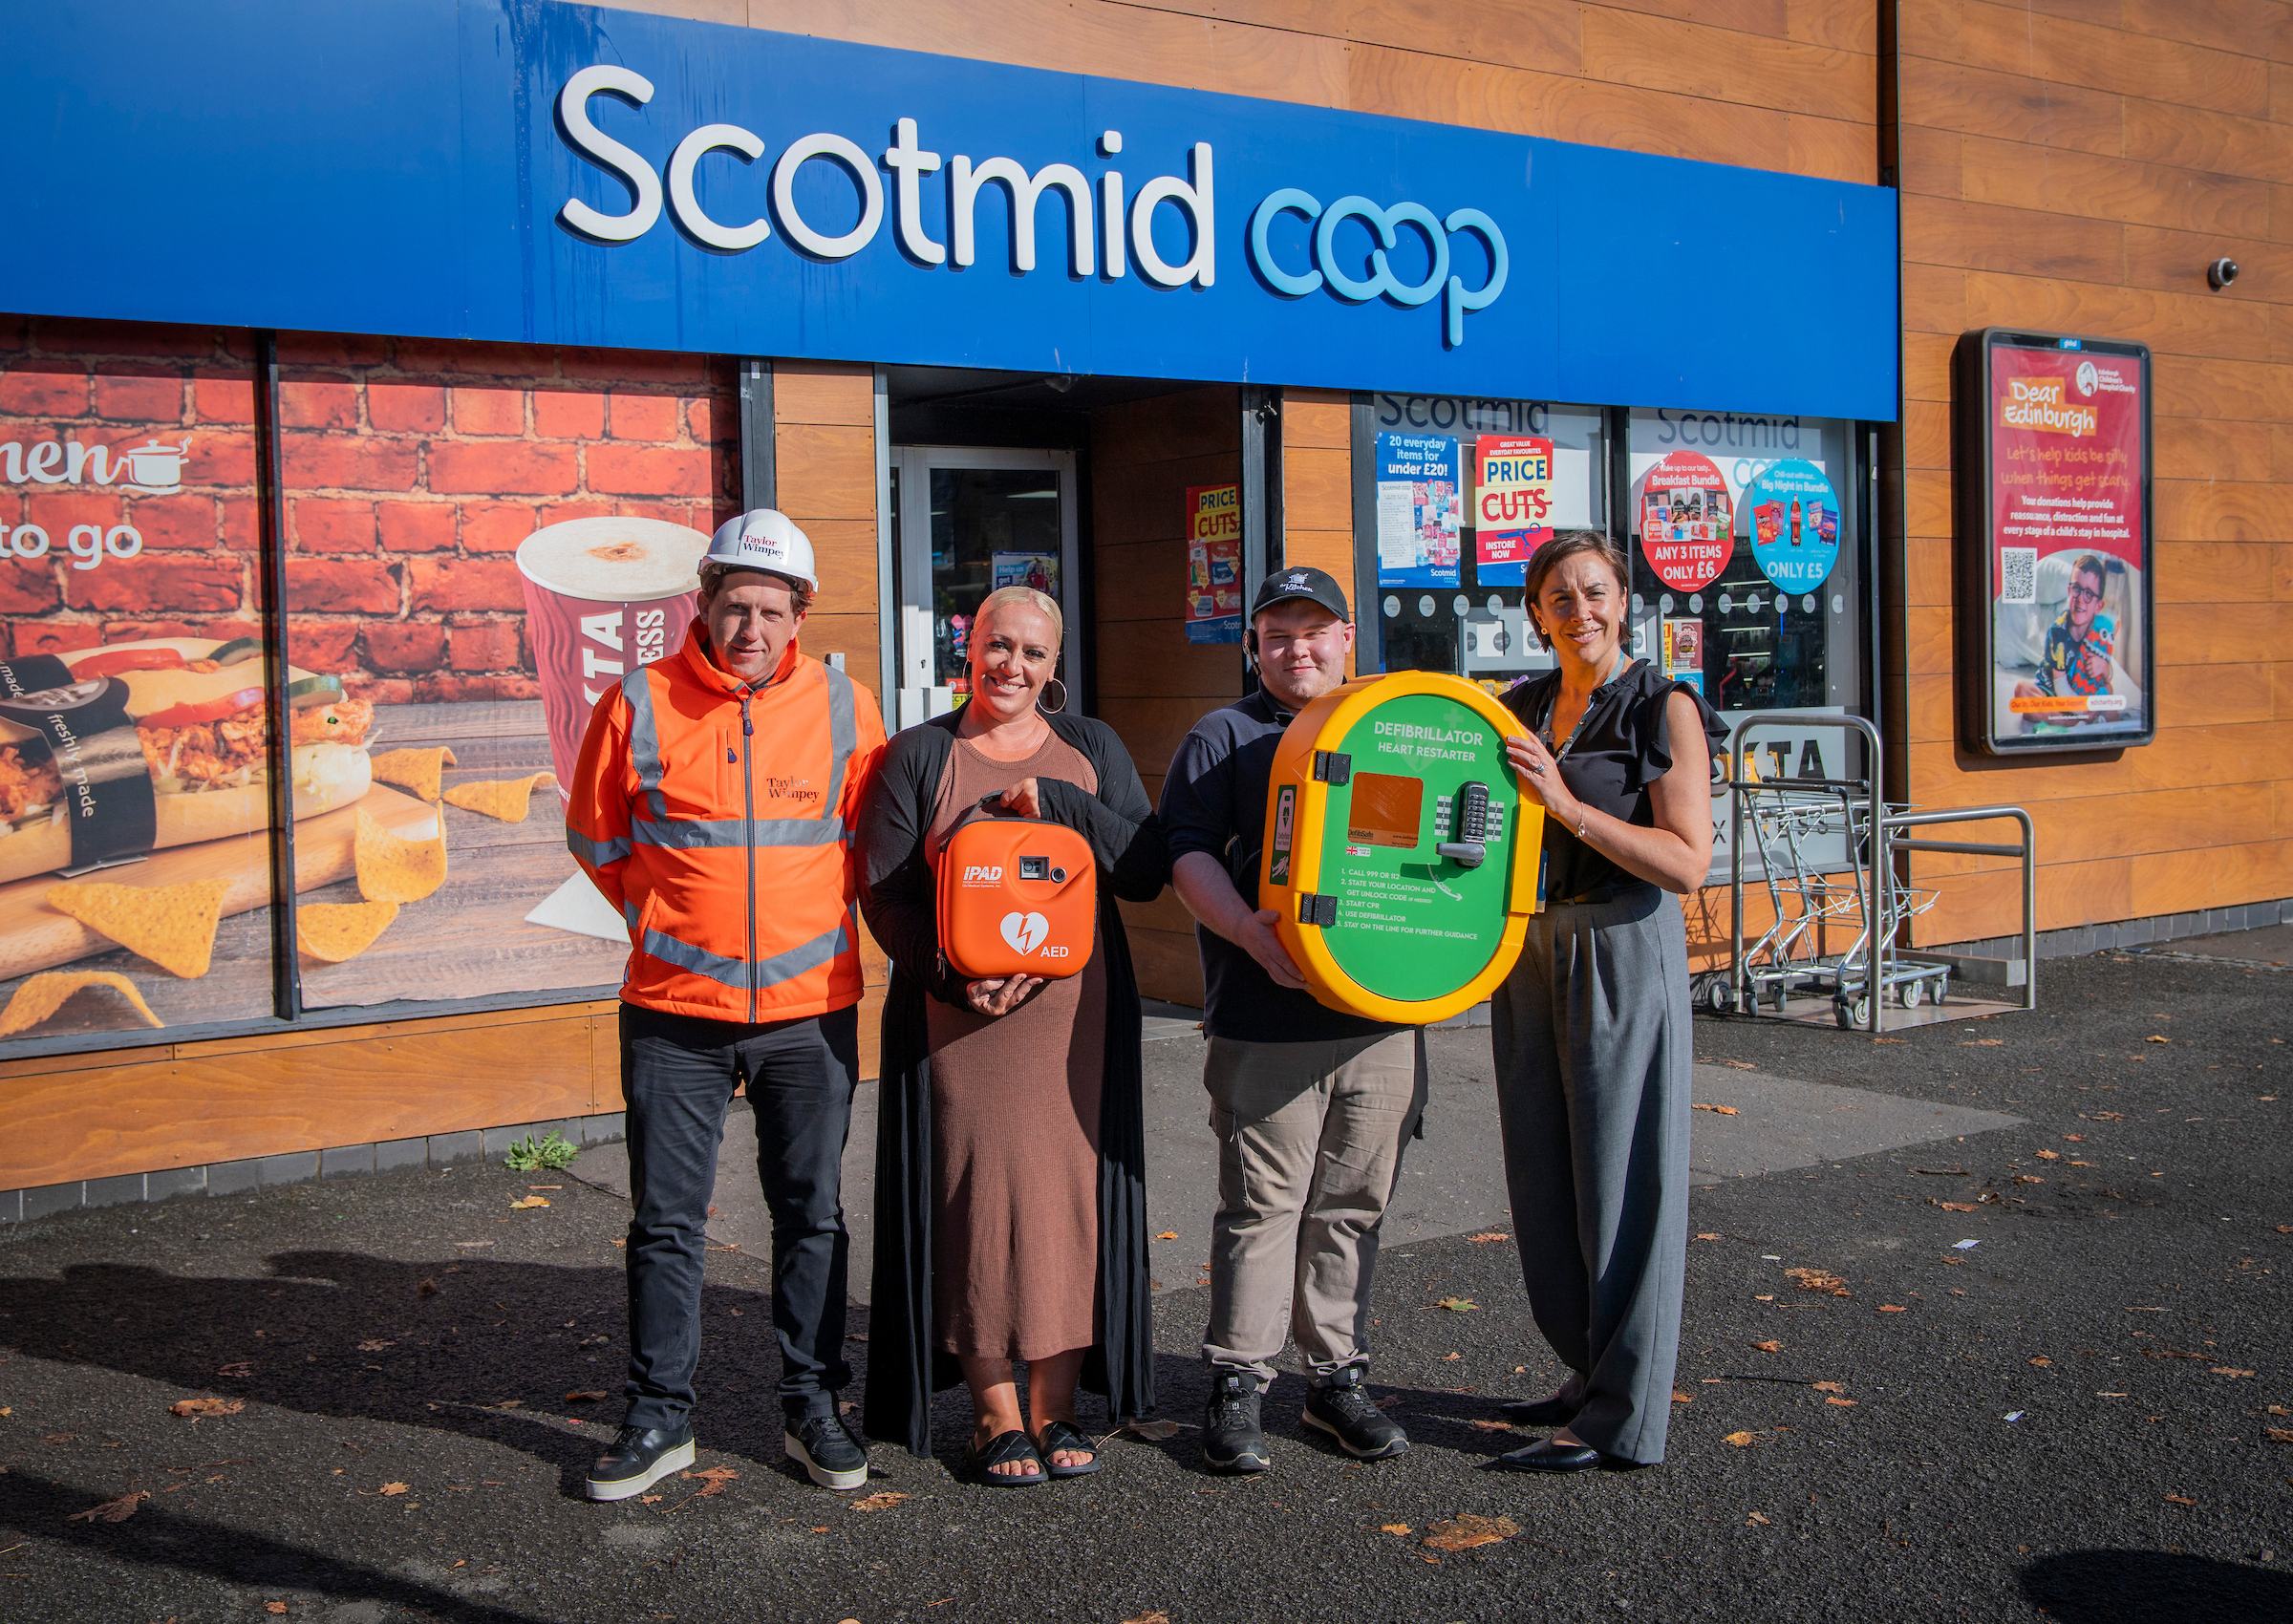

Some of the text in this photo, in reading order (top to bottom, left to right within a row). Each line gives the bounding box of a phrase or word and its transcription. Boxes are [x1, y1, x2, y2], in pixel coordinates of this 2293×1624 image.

[557, 64, 1509, 347] Scotmid coop
[2011, 382, 2060, 404] Dear
[2004, 402, 2094, 438] Edinburgh
[1658, 408, 1800, 450] Scotmid
[1389, 435, 1447, 452] 20 everyday
[1397, 448, 1439, 461] items for
[1489, 447, 1541, 457] EVERYDAY FAVOURITES
[2006, 445, 2128, 470] Let's help kids be silly
[1388, 462, 1447, 476] under £20!
[1488, 459, 1546, 482] PRICE
[1652, 475, 1720, 486] Breakfast Bundle
[1762, 480, 1829, 493] Big Night in Bundle
[2036, 470, 2072, 492] things
[2075, 471, 2096, 492] get
[1200, 489, 1235, 511] PRICE
[1482, 488, 1548, 522] CUTS
[2022, 495, 2113, 510] Your donations help provide
[1198, 511, 1237, 538] CUTS
[2053, 511, 2089, 523] distraction
[2089, 514, 2103, 524] and
[2104, 513, 2115, 524] fun
[2116, 515, 2124, 524] at
[2004, 526, 2024, 537] every
[2025, 526, 2043, 538] stage
[2043, 525, 2050, 535] of
[2056, 526, 2077, 537] child's
[2078, 528, 2092, 539] stay
[2093, 527, 2100, 537] in
[68, 524, 143, 570] go
[743, 534, 777, 546] Taylor
[1486, 540, 1516, 550] INSTORE
[743, 543, 783, 559] Wimpey
[1491, 549, 1510, 560] NOW
[1655, 545, 1722, 560] ANY 3 ITEMS
[998, 566, 1015, 575] Help
[1430, 568, 1456, 577] Scotmid
[1663, 561, 1715, 580] ONLY £6
[1767, 561, 1824, 579] ONLY £5
[998, 577, 1010, 586] get
[1374, 721, 1483, 746] DEFIBRILLATOR
[1378, 741, 1476, 762] HEART RESTARTER
[48, 713, 96, 818] freshly made
[766, 776, 808, 790] Taylor
[768, 788, 820, 802] Wimpey
[1348, 829, 1374, 838] DefibSafe
[963, 865, 1003, 881] IPAD
[1348, 879, 1367, 887] STATE
[1387, 883, 1421, 892] LOCATION
[1439, 881, 1452, 893] OPEN
[1361, 890, 1387, 899] UNLOCK
[1389, 893, 1407, 902] CODE
[1359, 912, 1406, 923] DEFIBRILLATOR
[1415, 928, 1443, 936] FURTHER
[1445, 930, 1478, 940] GUIDANCE
[1040, 946, 1069, 957] AED
